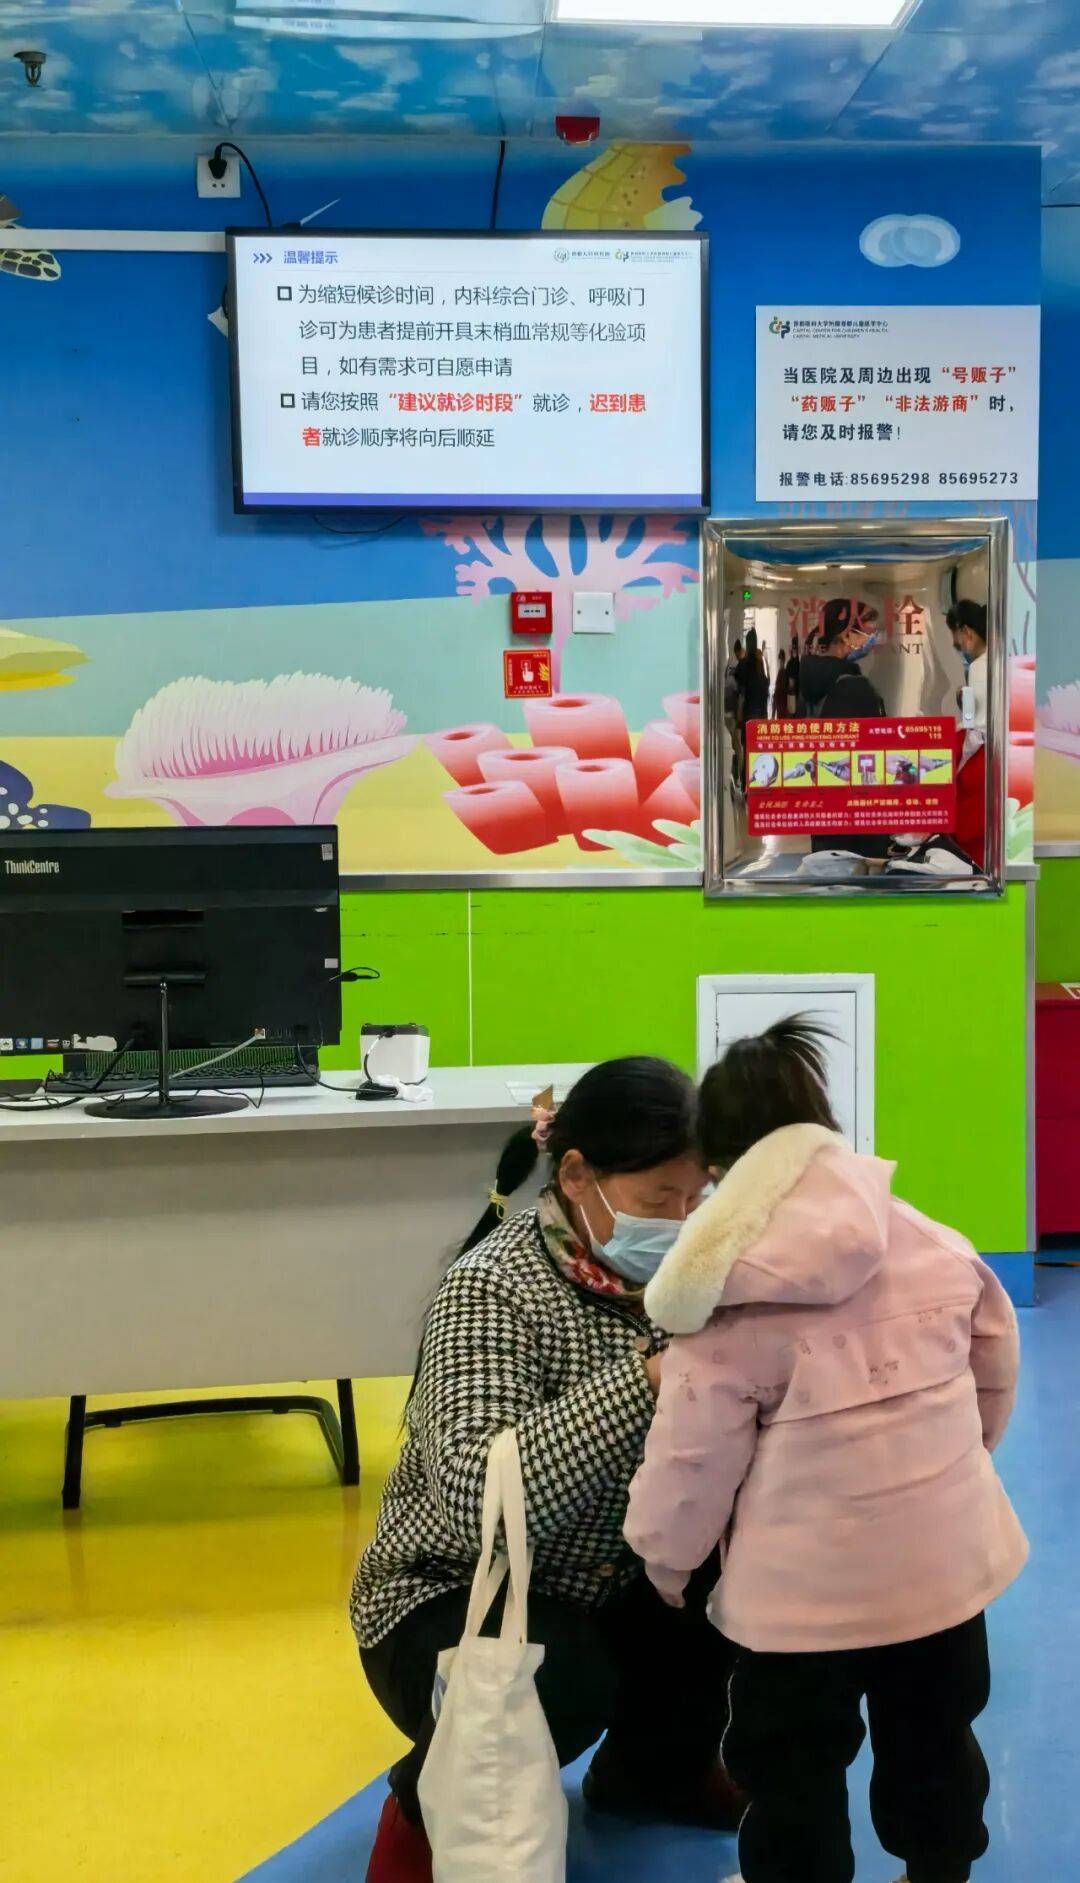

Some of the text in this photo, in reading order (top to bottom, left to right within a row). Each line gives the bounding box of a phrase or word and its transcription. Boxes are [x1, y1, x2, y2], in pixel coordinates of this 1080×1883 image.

[283, 250, 338, 264] 温馨提示
[298, 284, 645, 307] 为缩短候诊时间，内科综合门诊、呼吸门
[298, 320, 646, 343] 诊可为患者提前开具末梢血常规等化验项
[301, 355, 513, 377] 目，如有需求可自愿申请
[302, 427, 496, 448] 者就诊顺序将向后顺延
[939, 471, 1019, 485] 85695273
[757, 722, 860, 734] 消防栓的使用方法
[4, 860, 60, 874] ThinkCentre
